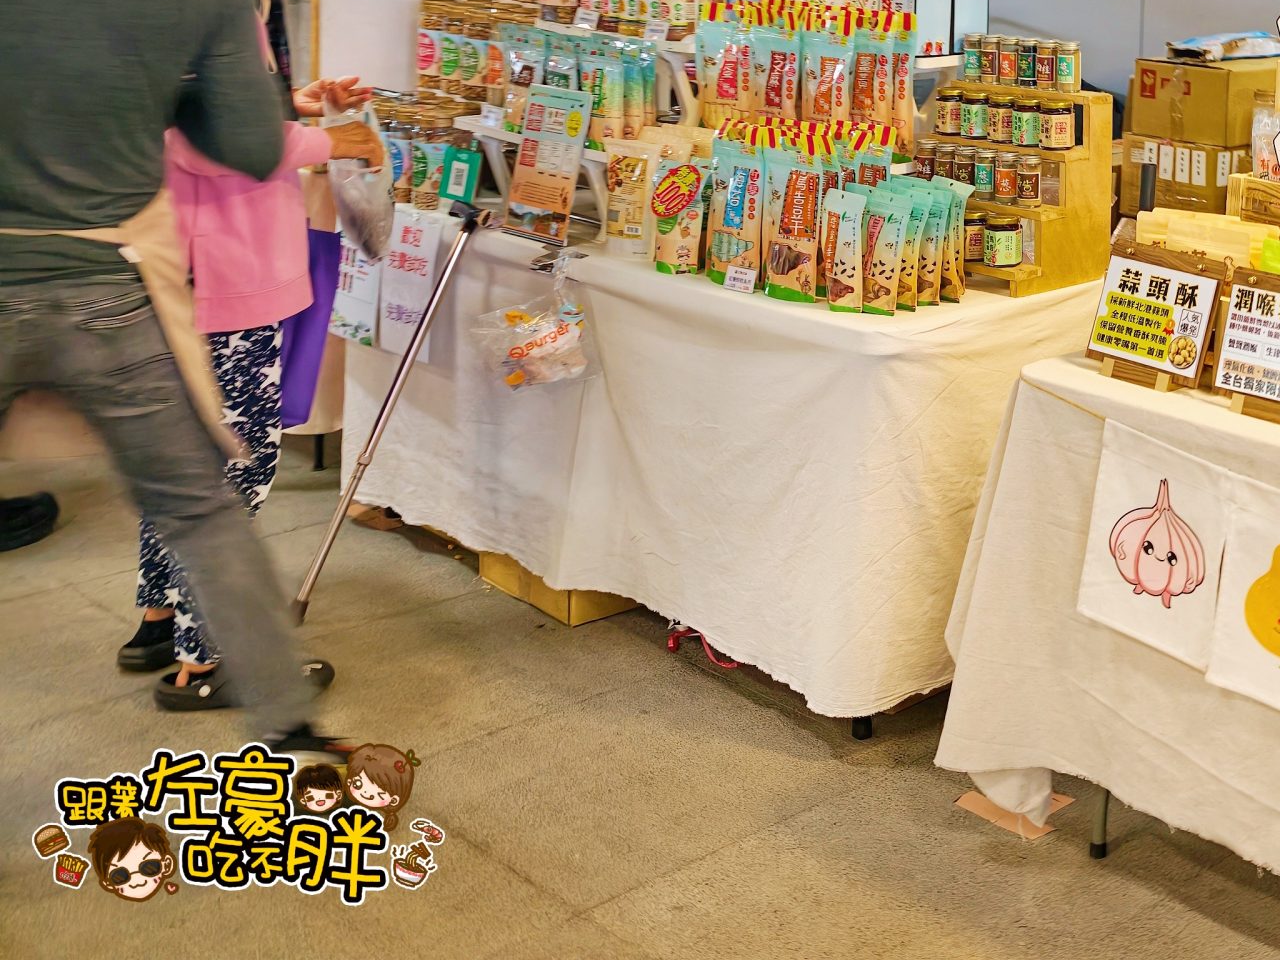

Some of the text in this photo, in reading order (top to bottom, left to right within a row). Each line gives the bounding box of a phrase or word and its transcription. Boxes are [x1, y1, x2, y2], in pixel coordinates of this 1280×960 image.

[1118, 268, 1199, 309] 蒜頭酥
[1111, 309, 1162, 330] 全程低溫製作
